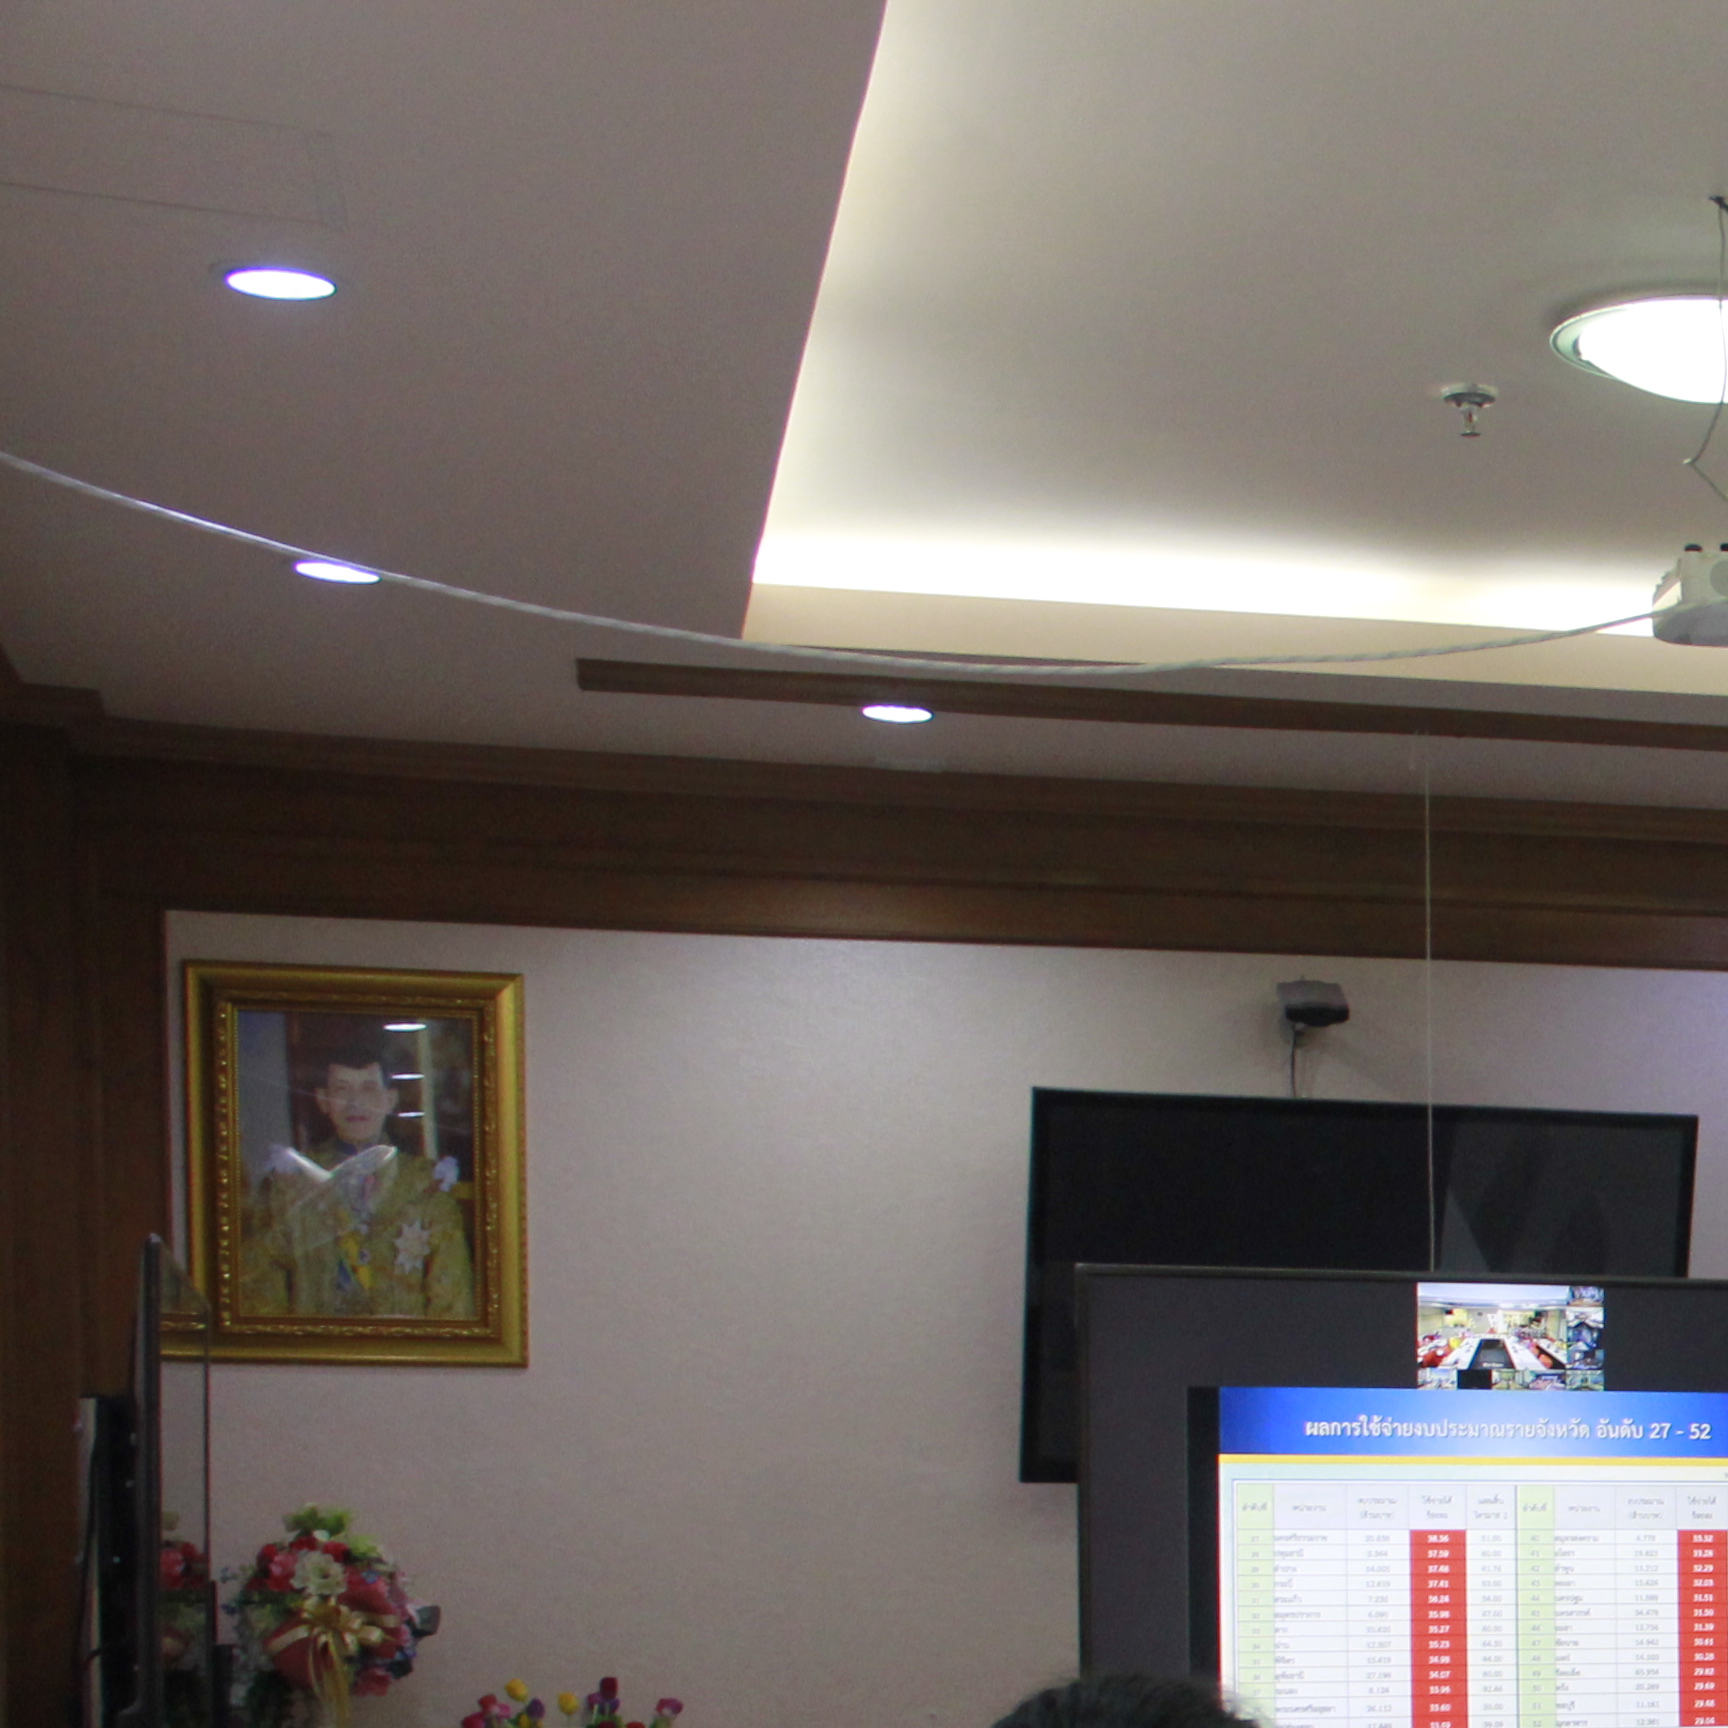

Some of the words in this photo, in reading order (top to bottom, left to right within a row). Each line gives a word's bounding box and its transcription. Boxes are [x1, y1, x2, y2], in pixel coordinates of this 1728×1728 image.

[1305, 1415, 1590, 1440] ผลการใช้จ่ายงบประมาณรายจังหวัด
[1595, 1418, 1644, 1439] อันดับ
[1649, 1423, 1670, 1439] 27
[1689, 1423, 1712, 1440] 52
